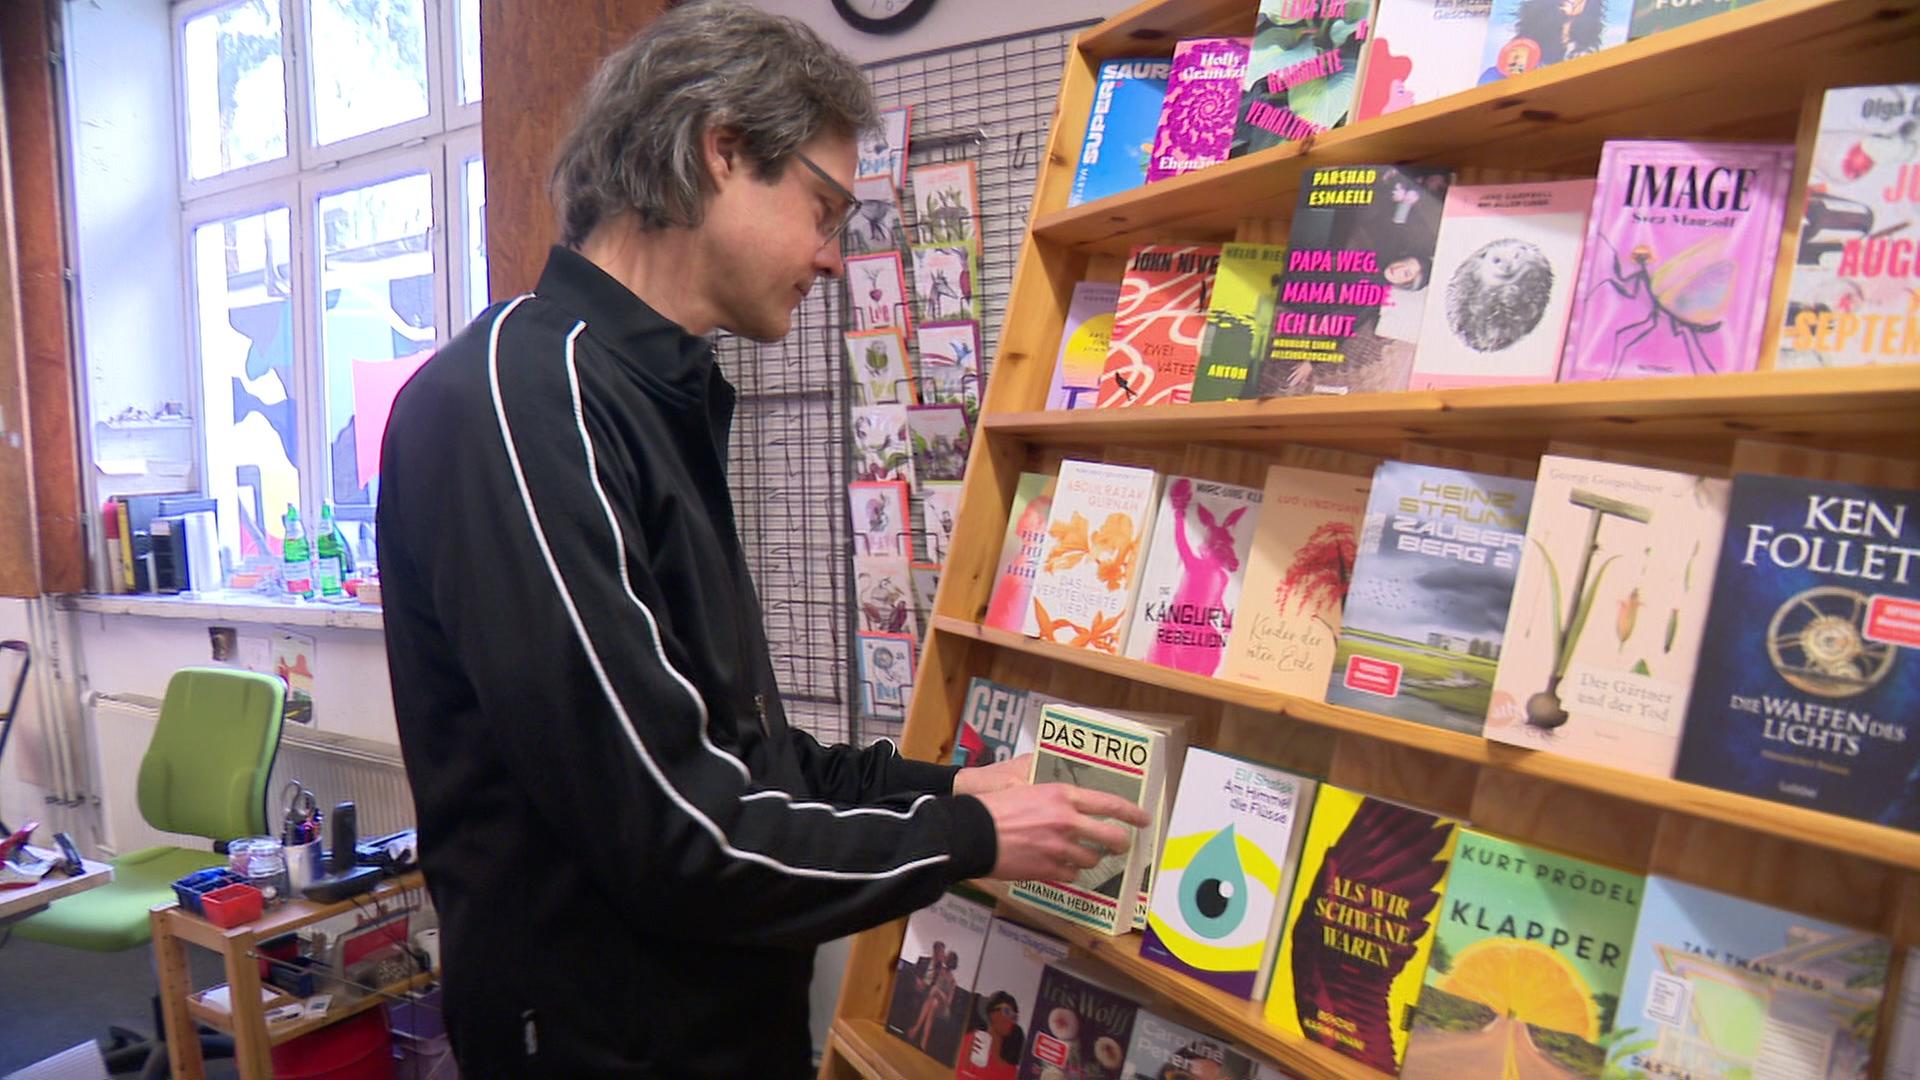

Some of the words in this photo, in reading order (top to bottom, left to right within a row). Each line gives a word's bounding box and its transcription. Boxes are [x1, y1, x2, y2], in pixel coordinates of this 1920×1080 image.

[1200, 51, 1245, 69] Holly
[1083, 80, 1117, 165] SUPER
[1862, 97, 1906, 122] Olga
[1313, 170, 1377, 186] PARSHAD
[1622, 164, 1758, 212] IMAGE
[1309, 189, 1374, 206] ESMAEILI
[1132, 251, 1172, 272] JOHN
[1289, 250, 1333, 273] PAPA
[1336, 250, 1380, 274] WEG.
[1282, 281, 1337, 304] MAMA
[1338, 278, 1396, 307] MÜDE.
[1276, 312, 1306, 335] ICH
[1307, 314, 1358, 338] LAUT.
[1420, 481, 1518, 510] HEINZ
[1804, 495, 1907, 539] KEN
[1397, 534, 1488, 565] BERG
[1492, 551, 1514, 569] 2
[1157, 628, 1228, 648] REBELLION
[1730, 694, 1761, 714] DIE
[1761, 695, 1871, 734] WAFFEN
[1042, 719, 1085, 750] DAS
[1092, 734, 1147, 766] TRIO
[1762, 718, 1860, 756] LICHTS
[1461, 844, 1526, 874] KURT
[1535, 862, 1637, 906] PRÖDEL
[1065, 896, 1117, 922] HEDMAN
[1326, 877, 1366, 903] ALS
[1371, 887, 1411, 920] WIR
[1314, 896, 1411, 947] SCHWÄNE
[1450, 899, 1621, 968] KLAPPER
[1323, 925, 1392, 968] WAREN
